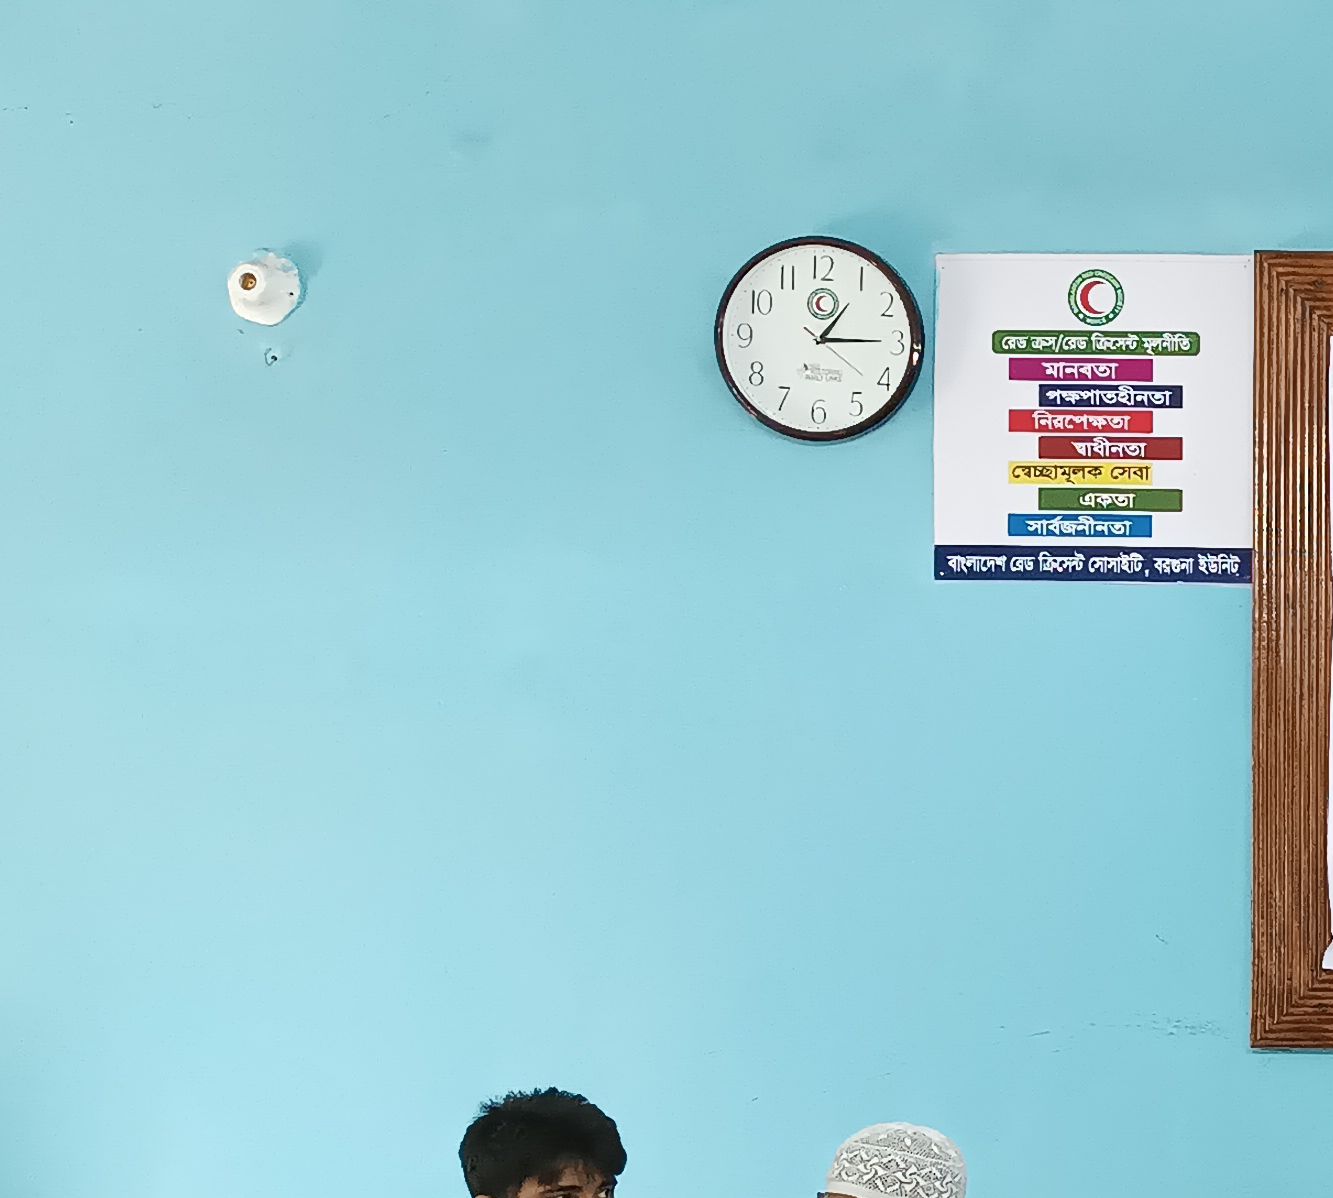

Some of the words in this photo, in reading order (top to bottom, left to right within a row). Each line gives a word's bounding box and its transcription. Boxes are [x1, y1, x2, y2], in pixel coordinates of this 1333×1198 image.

[780, 264, 795, 290] 11
[813, 255, 835, 282] 12
[859, 266, 864, 292] 1
[751, 289, 773, 315] 10
[880, 291, 894, 318] 2
[736, 322, 754, 349] 9
[889, 330, 905, 356] 3
[1001, 335, 1029, 351] রেড
[1143, 333, 1191, 356] মূলনীতি
[749, 360, 764, 387] 8
[876, 366, 891, 392] 4
[1041, 361, 1119, 379] মানবতা
[778, 385, 791, 411] 7
[849, 391, 864, 416] 5
[1045, 384, 1173, 407] পক্ষপাতহীনতা
[811, 399, 827, 424] 6
[1032, 409, 1131, 430] নিরপেক্ষতা
[1071, 437, 1147, 458] স্বাধীনতা
[1012, 464, 1104, 485] স্বেচ্ছামূলক
[1110, 464, 1151, 480] সেবা
[1079, 491, 1136, 509] একতা
[1026, 515, 1133, 537] সার্বজনীনতা
[946, 554, 1007, 575] বাংলাদেশ
[1010, 556, 1036, 573] রেড
[1038, 549, 1086, 573] ক্রিসেন্ট
[1153, 557, 1195, 575] বরগুনা
[1198, 553, 1241, 576] ইউনিট
